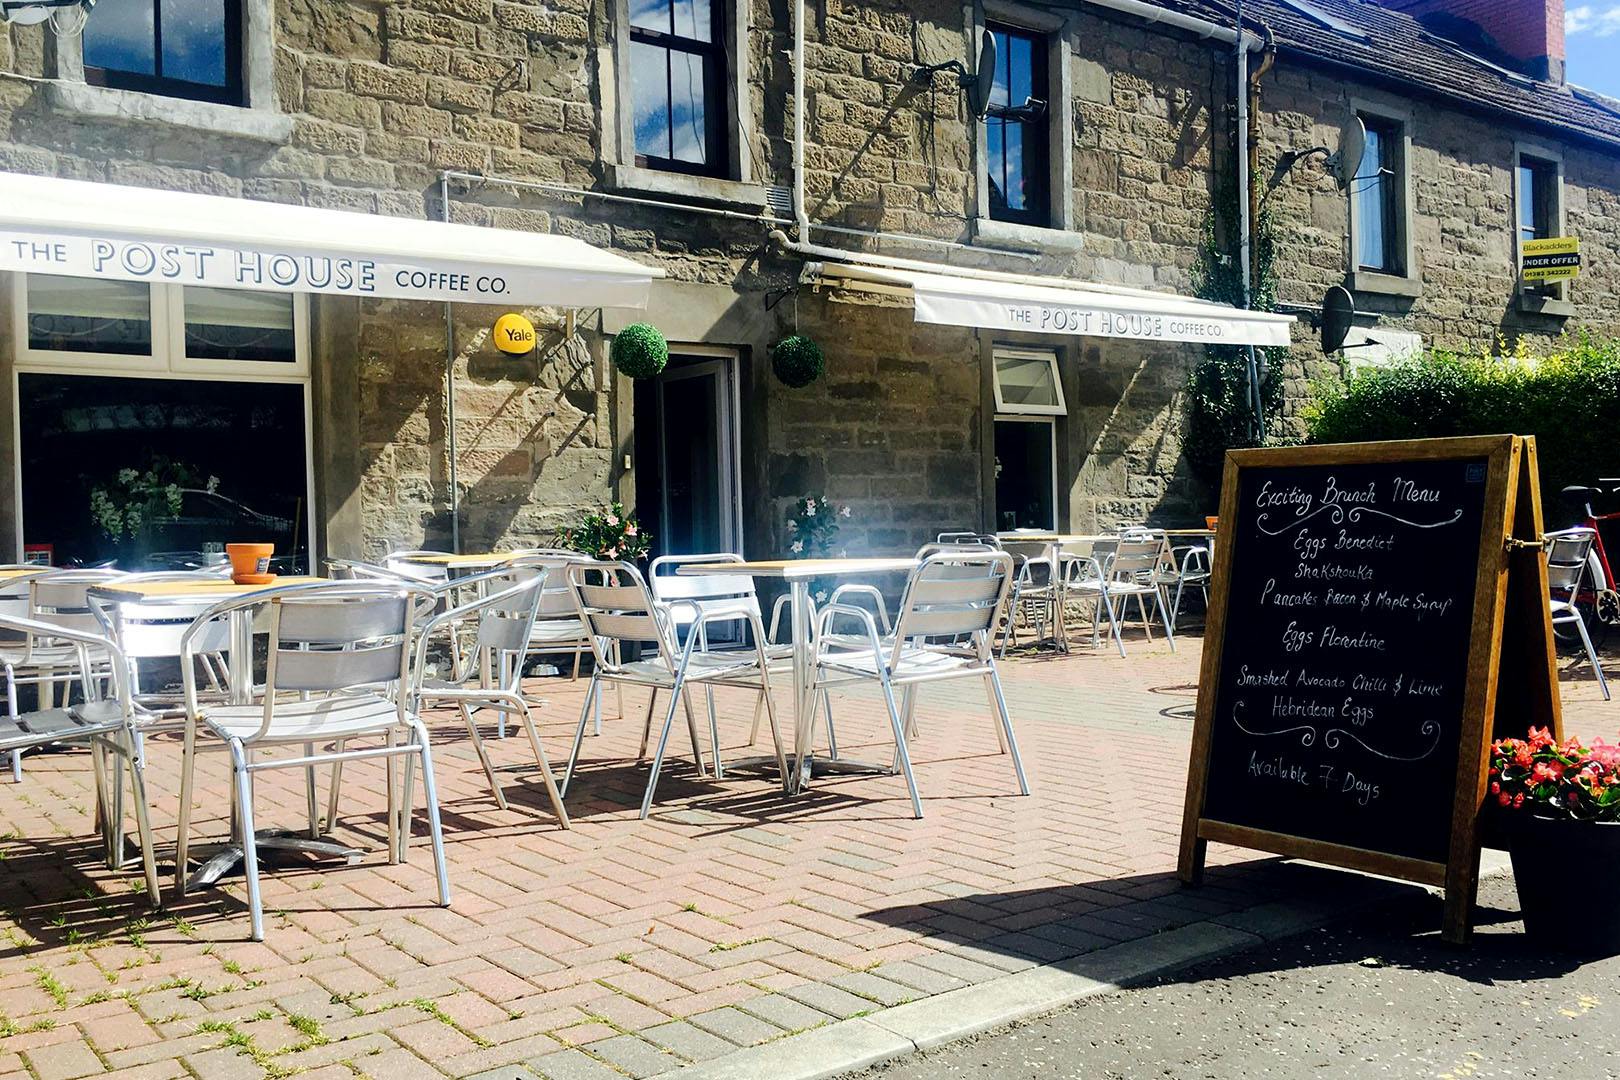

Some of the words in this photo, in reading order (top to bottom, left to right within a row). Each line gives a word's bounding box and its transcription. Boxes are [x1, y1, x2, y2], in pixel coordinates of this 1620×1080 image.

[11, 240, 67, 262] THE
[91, 239, 214, 279] POST
[233, 251, 375, 292] HOUSE
[395, 270, 469, 292] COFFEE
[476, 277, 511, 295] CO.
[505, 328, 533, 342] Yale
[1009, 309, 1031, 323] THE
[1041, 309, 1092, 331] POST
[1100, 312, 1162, 336] HOUSE
[1170, 321, 1204, 335] COFFEE
[1207, 324, 1225, 337] CO.
[1256, 480, 1313, 516] Exciting
[1319, 476, 1376, 504] Brunch
[1392, 476, 1441, 503] Menu
[1293, 528, 1327, 560] Eggs
[1334, 529, 1395, 550] Benedict
[1375, 591, 1409, 610] Maple
[1412, 593, 1453, 619] Syrup
[1282, 620, 1314, 652] Eggs
[1319, 625, 1386, 651] Florentine
[1236, 664, 1290, 687] Smashed
[1295, 668, 1346, 689] Avocado
[1408, 678, 1443, 697] Lime
[1272, 695, 1335, 718] Hebridean
[1341, 696, 1374, 727] Eggs
[1248, 750, 1310, 786] Available
[1319, 764, 1337, 789] 7
[1341, 771, 1380, 806] Days
